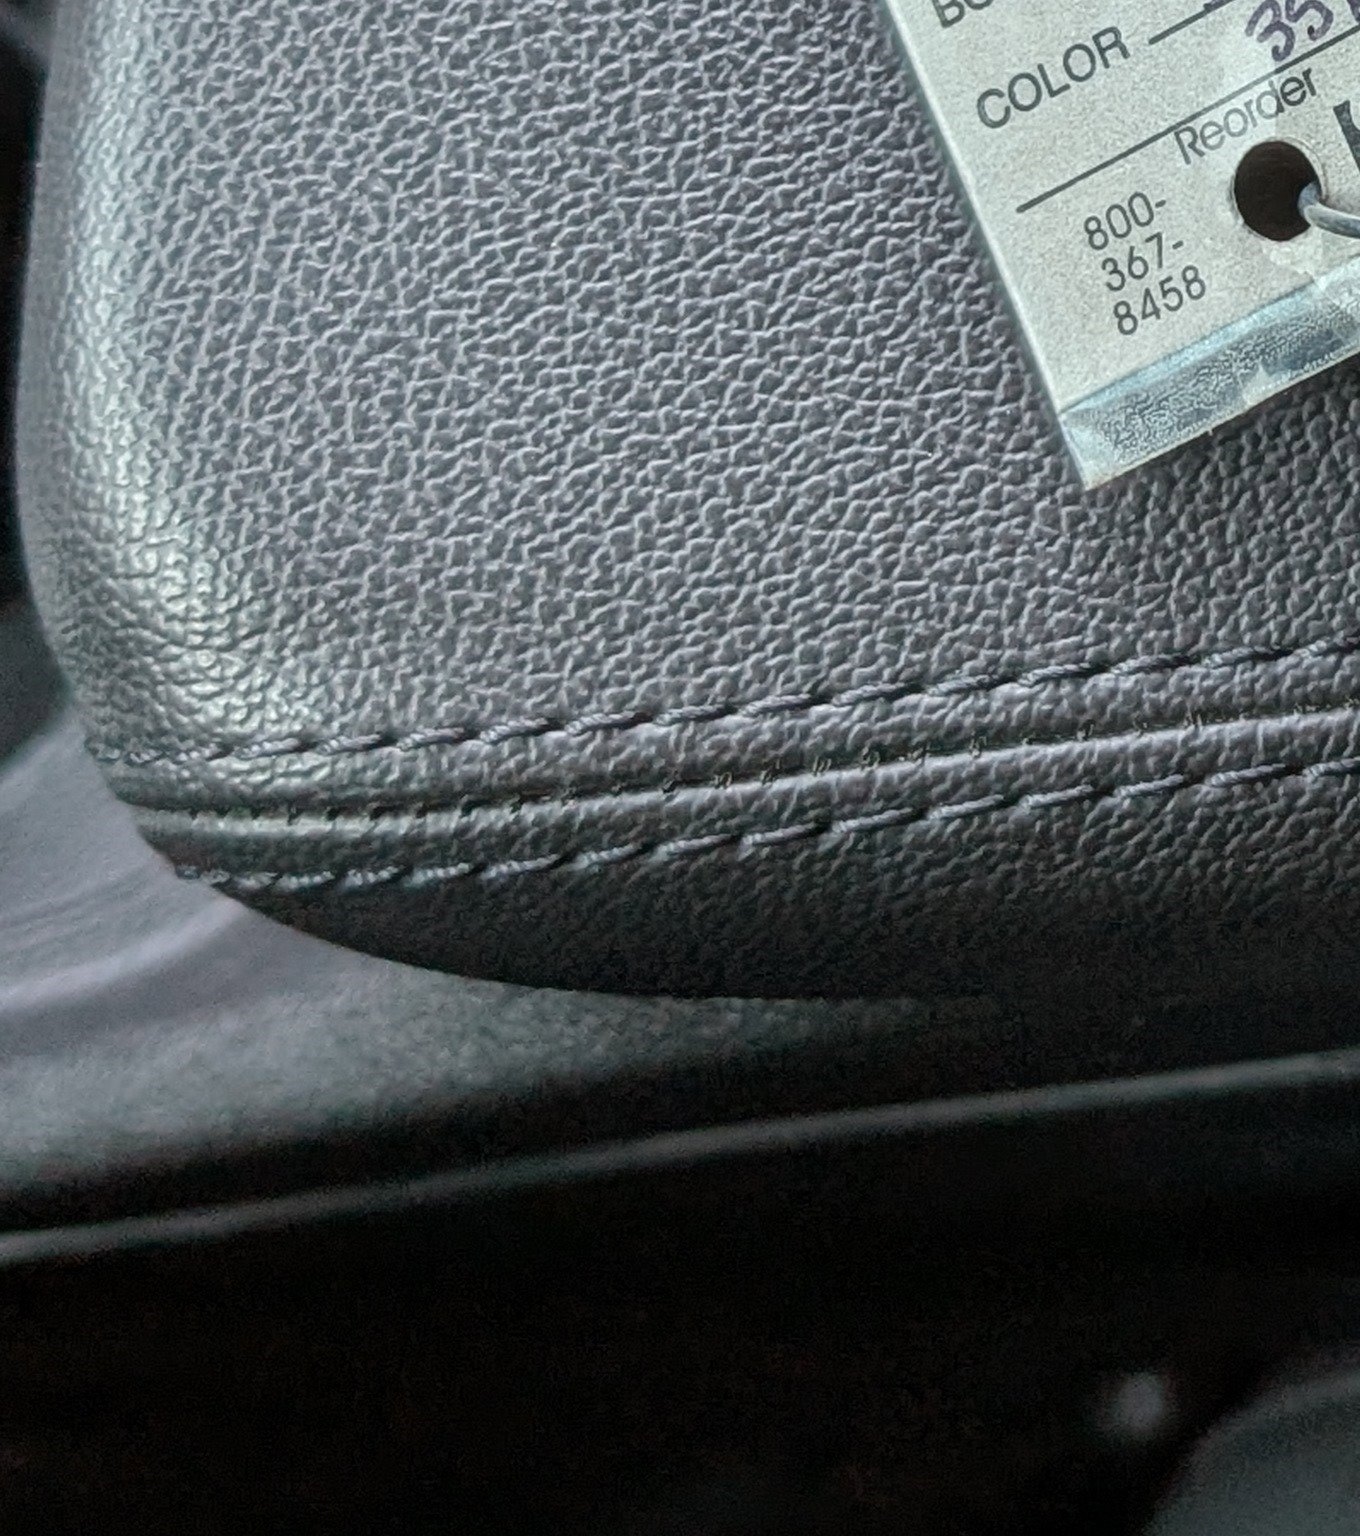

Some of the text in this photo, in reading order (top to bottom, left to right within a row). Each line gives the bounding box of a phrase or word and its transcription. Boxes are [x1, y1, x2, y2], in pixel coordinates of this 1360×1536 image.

[975, 26, 1131, 129] COLOR
[1173, 66, 1319, 165] Reorder
[1082, 194, 1167, 252] 800-
[1100, 238, 1184, 293] 367-
[1112, 268, 1206, 336] 8458
